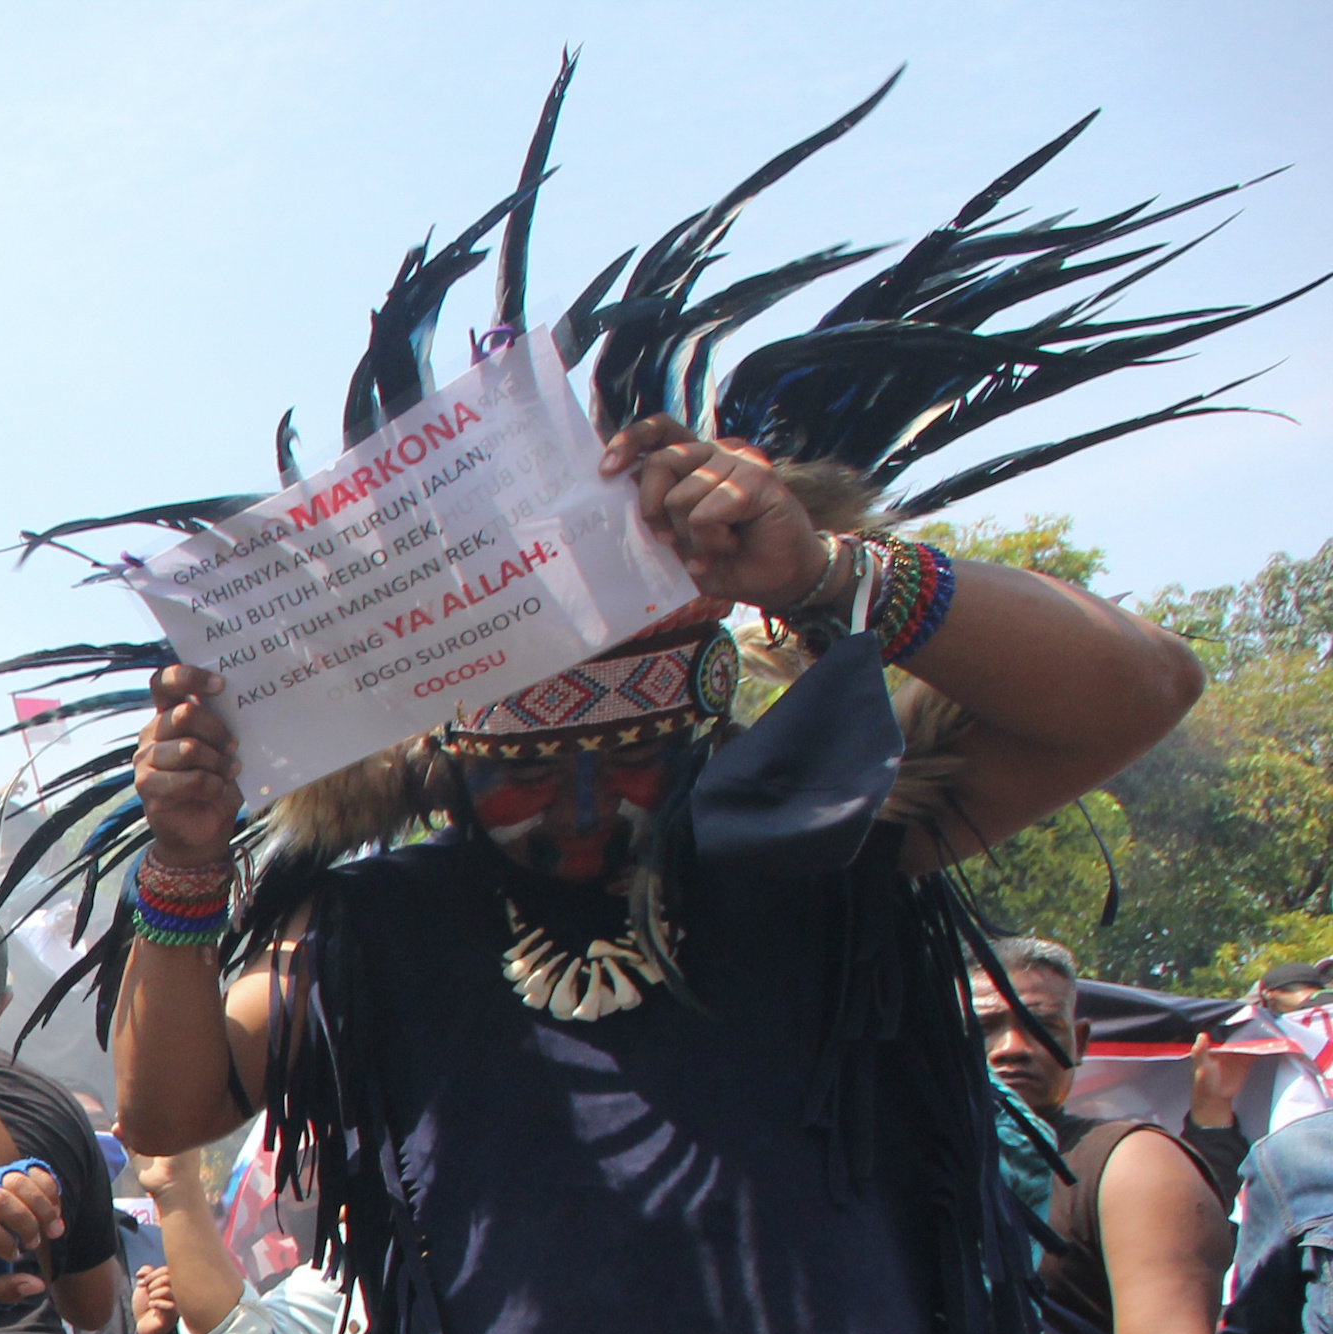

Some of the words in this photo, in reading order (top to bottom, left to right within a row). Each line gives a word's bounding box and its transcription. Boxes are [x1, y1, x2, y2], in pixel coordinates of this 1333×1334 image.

[173, 525, 291, 586] GARA-GARA
[286, 401, 482, 532] MARKONA
[189, 560, 290, 614] AKHIRNYA
[293, 538, 335, 569] AKU
[337, 491, 419, 545] TURUN
[422, 446, 492, 499] JALAN,
[205, 615, 243, 642] AKU
[246, 581, 319, 625] BUTUH
[322, 549, 388, 592] KERJO
[393, 519, 443, 555] REK,
[219, 644, 257, 673] AKU
[260, 612, 334, 654] BUTUH
[337, 558, 441, 619] MANGAN
[445, 529, 496, 565] REK,
[237, 681, 277, 709] AKU
[280, 661, 320, 689] SEK
[321, 632, 384, 670] ELING
[383, 608, 434, 639] YA
[442, 541, 558, 618] ALLAH.
[354, 656, 411, 693] JOGO
[416, 597, 542, 666] SUROBOYO
[414, 649, 507, 698] COCOSU
